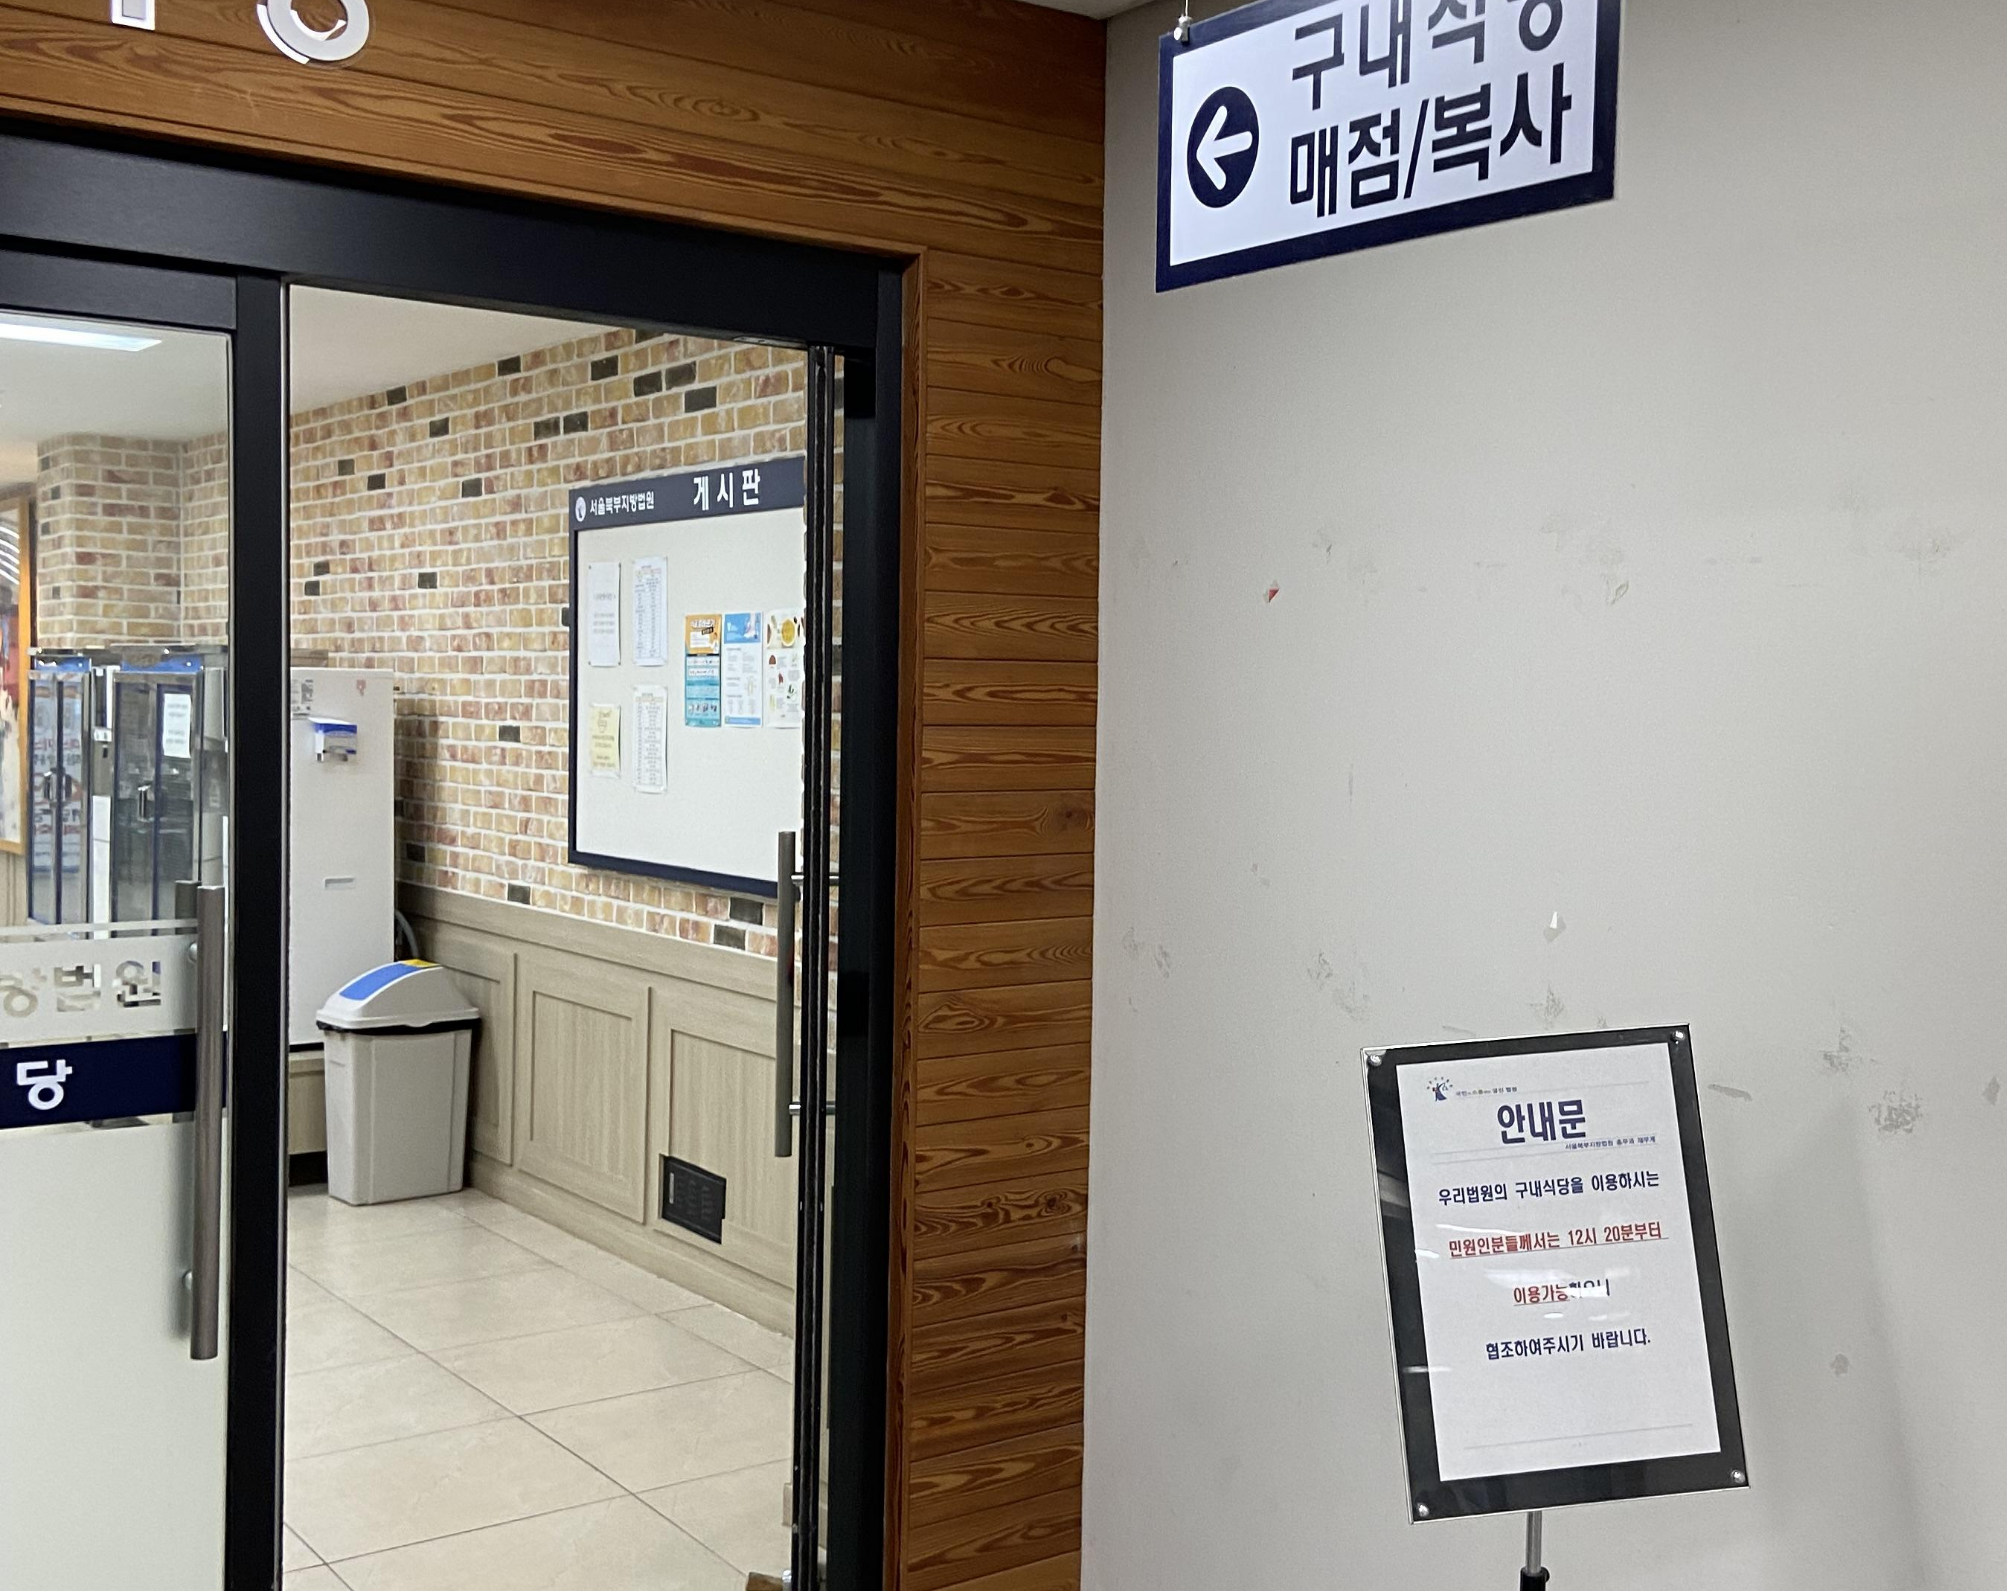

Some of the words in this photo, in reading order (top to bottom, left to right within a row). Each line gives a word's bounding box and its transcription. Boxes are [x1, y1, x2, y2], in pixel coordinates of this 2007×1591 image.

[1290, 62, 1572, 218] 매점/복사
[589, 491, 655, 516] 서울북부지방법원
[16, 1059, 73, 1110] 당
[1497, 1099, 1586, 1145] 안내문
[1438, 1183, 1508, 1206] 우리법원의
[1515, 1176, 1584, 1199] 구내식당을
[1591, 1170, 1660, 1193] 이용하시는
[1449, 1234, 1560, 1257] 민원인분들께서는
[1567, 1227, 1597, 1246] 12시
[1604, 1221, 1661, 1242] 20분부터
[1486, 1335, 1584, 1361] 협조하여주시기
[1592, 1328, 1651, 1350] 바랍니다.
